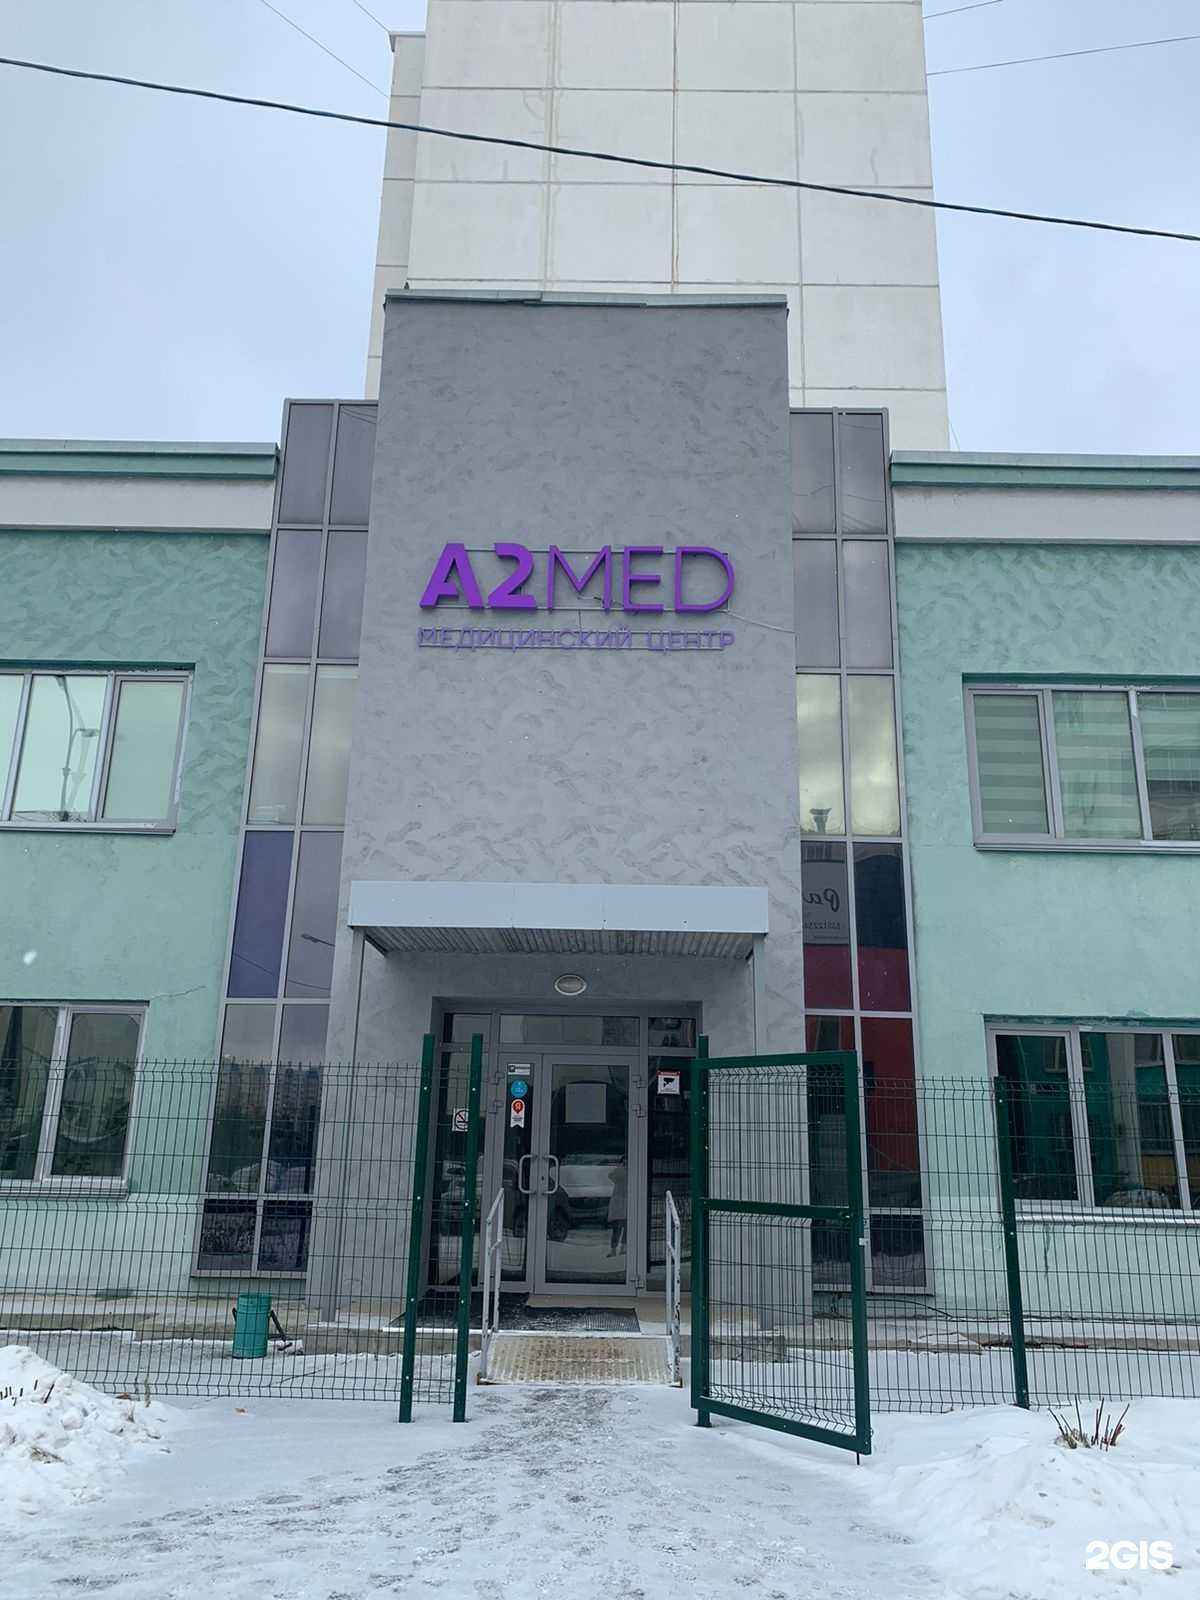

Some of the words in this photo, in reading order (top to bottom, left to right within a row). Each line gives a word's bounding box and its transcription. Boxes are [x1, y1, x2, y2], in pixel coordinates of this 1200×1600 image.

[419, 541, 735, 613] A2MED
[417, 624, 632, 653] МЕДИЦИНСКИЙ
[648, 630, 735, 655] ЦЕНТР
